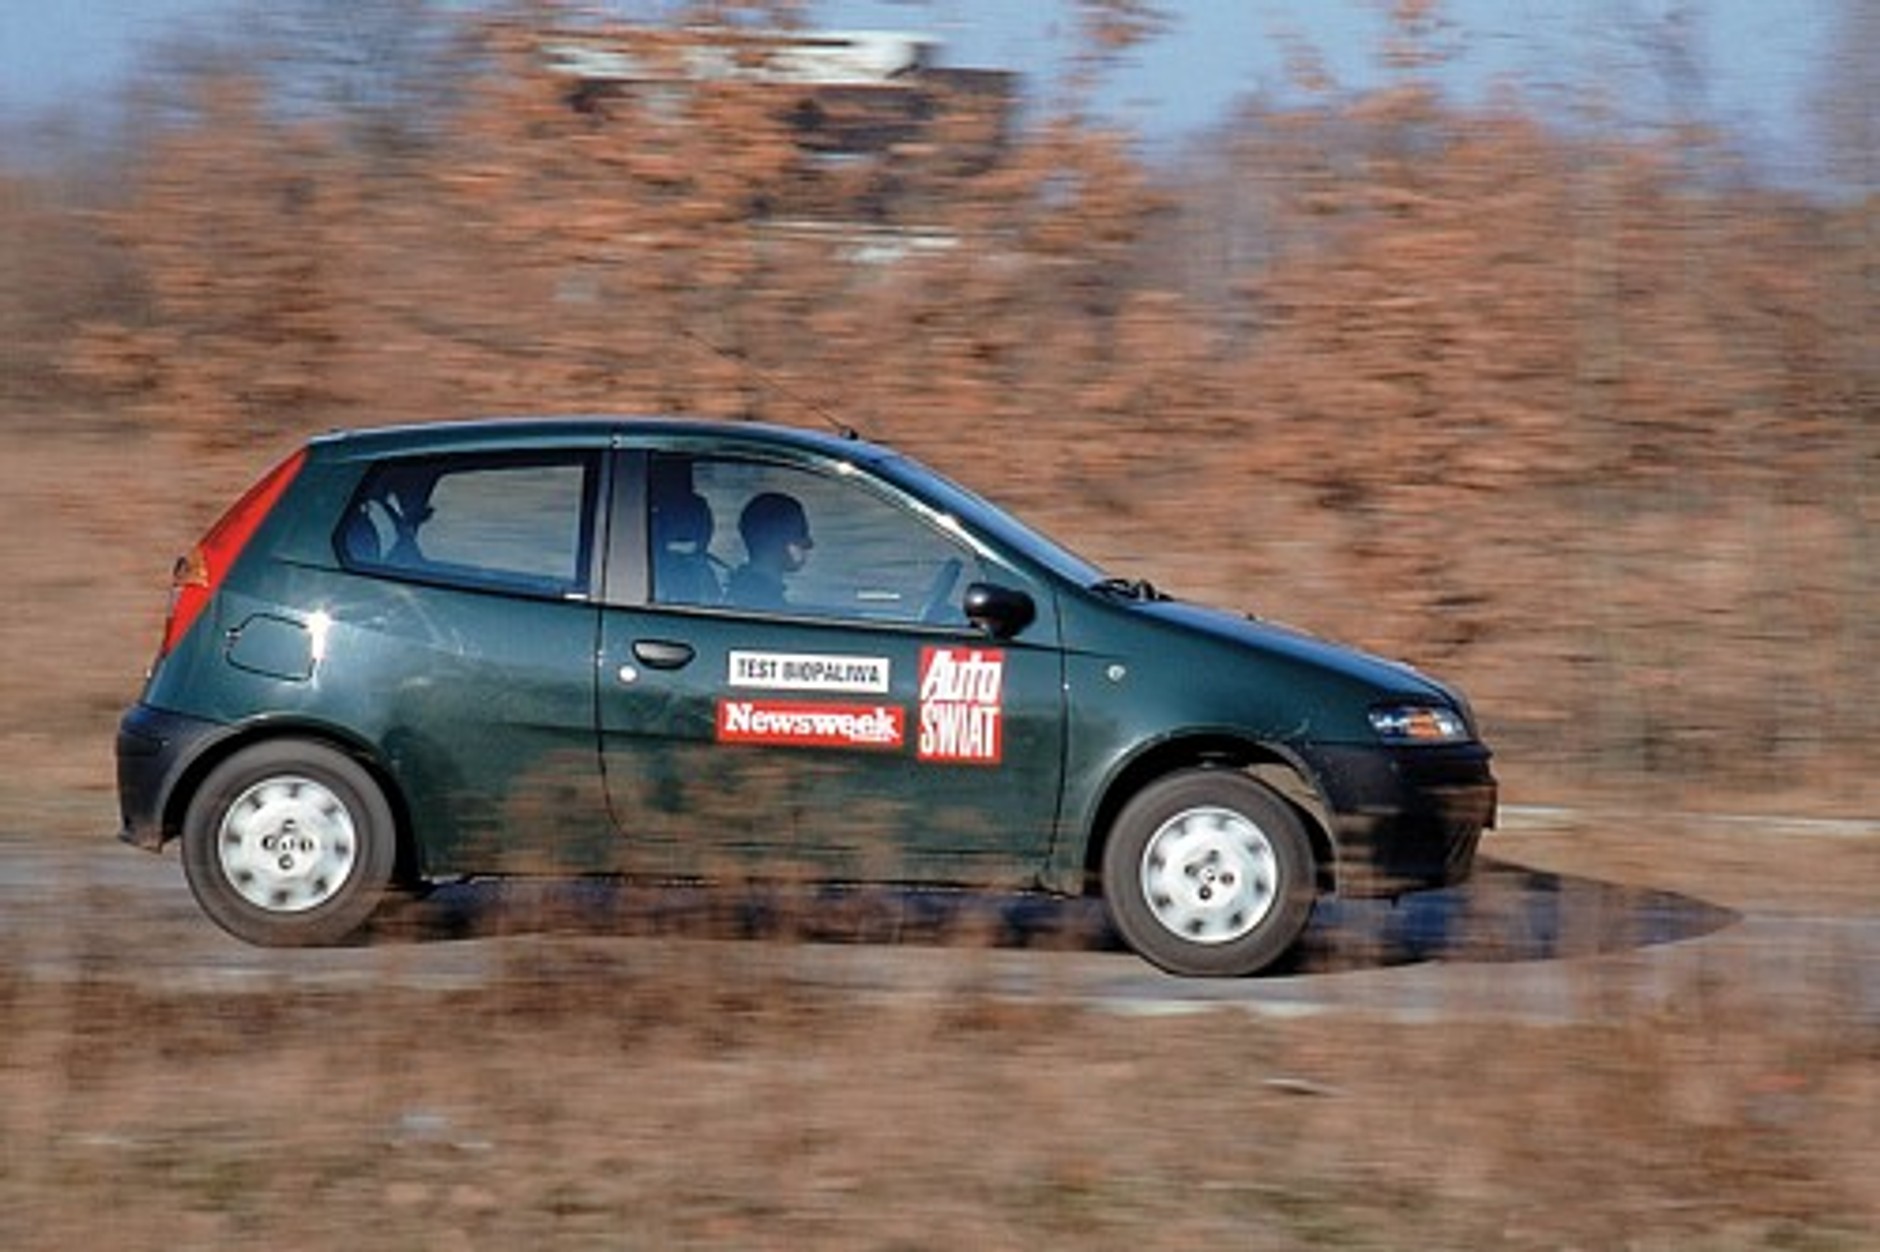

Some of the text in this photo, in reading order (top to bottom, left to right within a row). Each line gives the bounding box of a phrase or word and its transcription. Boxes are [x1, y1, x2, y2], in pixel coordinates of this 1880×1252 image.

[737, 658, 777, 679] TEST
[921, 650, 1001, 703] Auto
[725, 702, 899, 741] Newsweek
